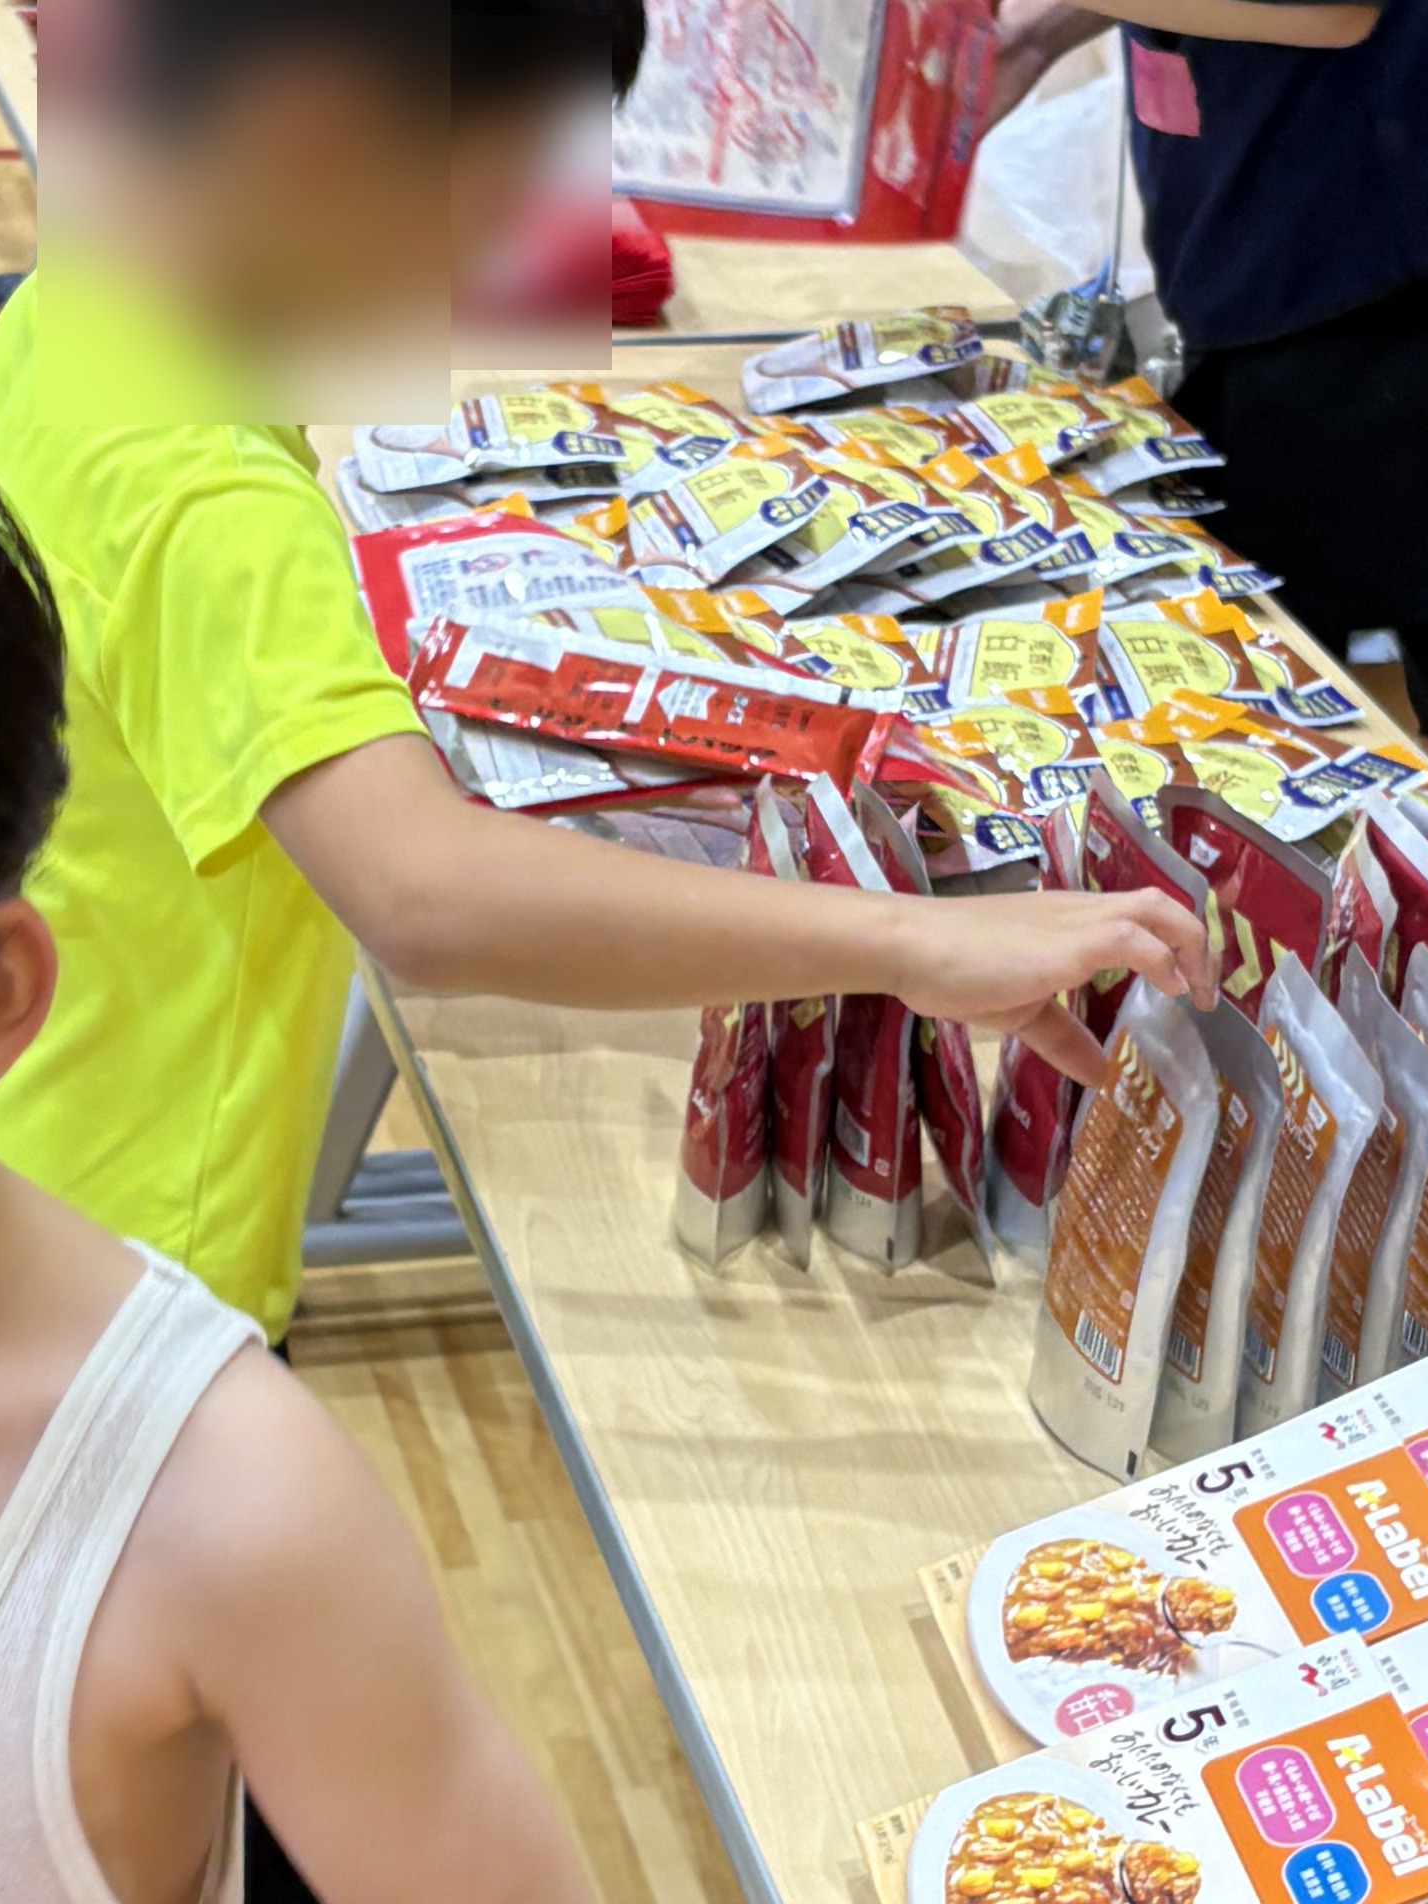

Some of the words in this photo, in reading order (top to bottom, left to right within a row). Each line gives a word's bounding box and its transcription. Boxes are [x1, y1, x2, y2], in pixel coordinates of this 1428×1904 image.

[1090, 1751, 1172, 1835] おいしいカレー
[1111, 1729, 1201, 1817] あたためなくても
